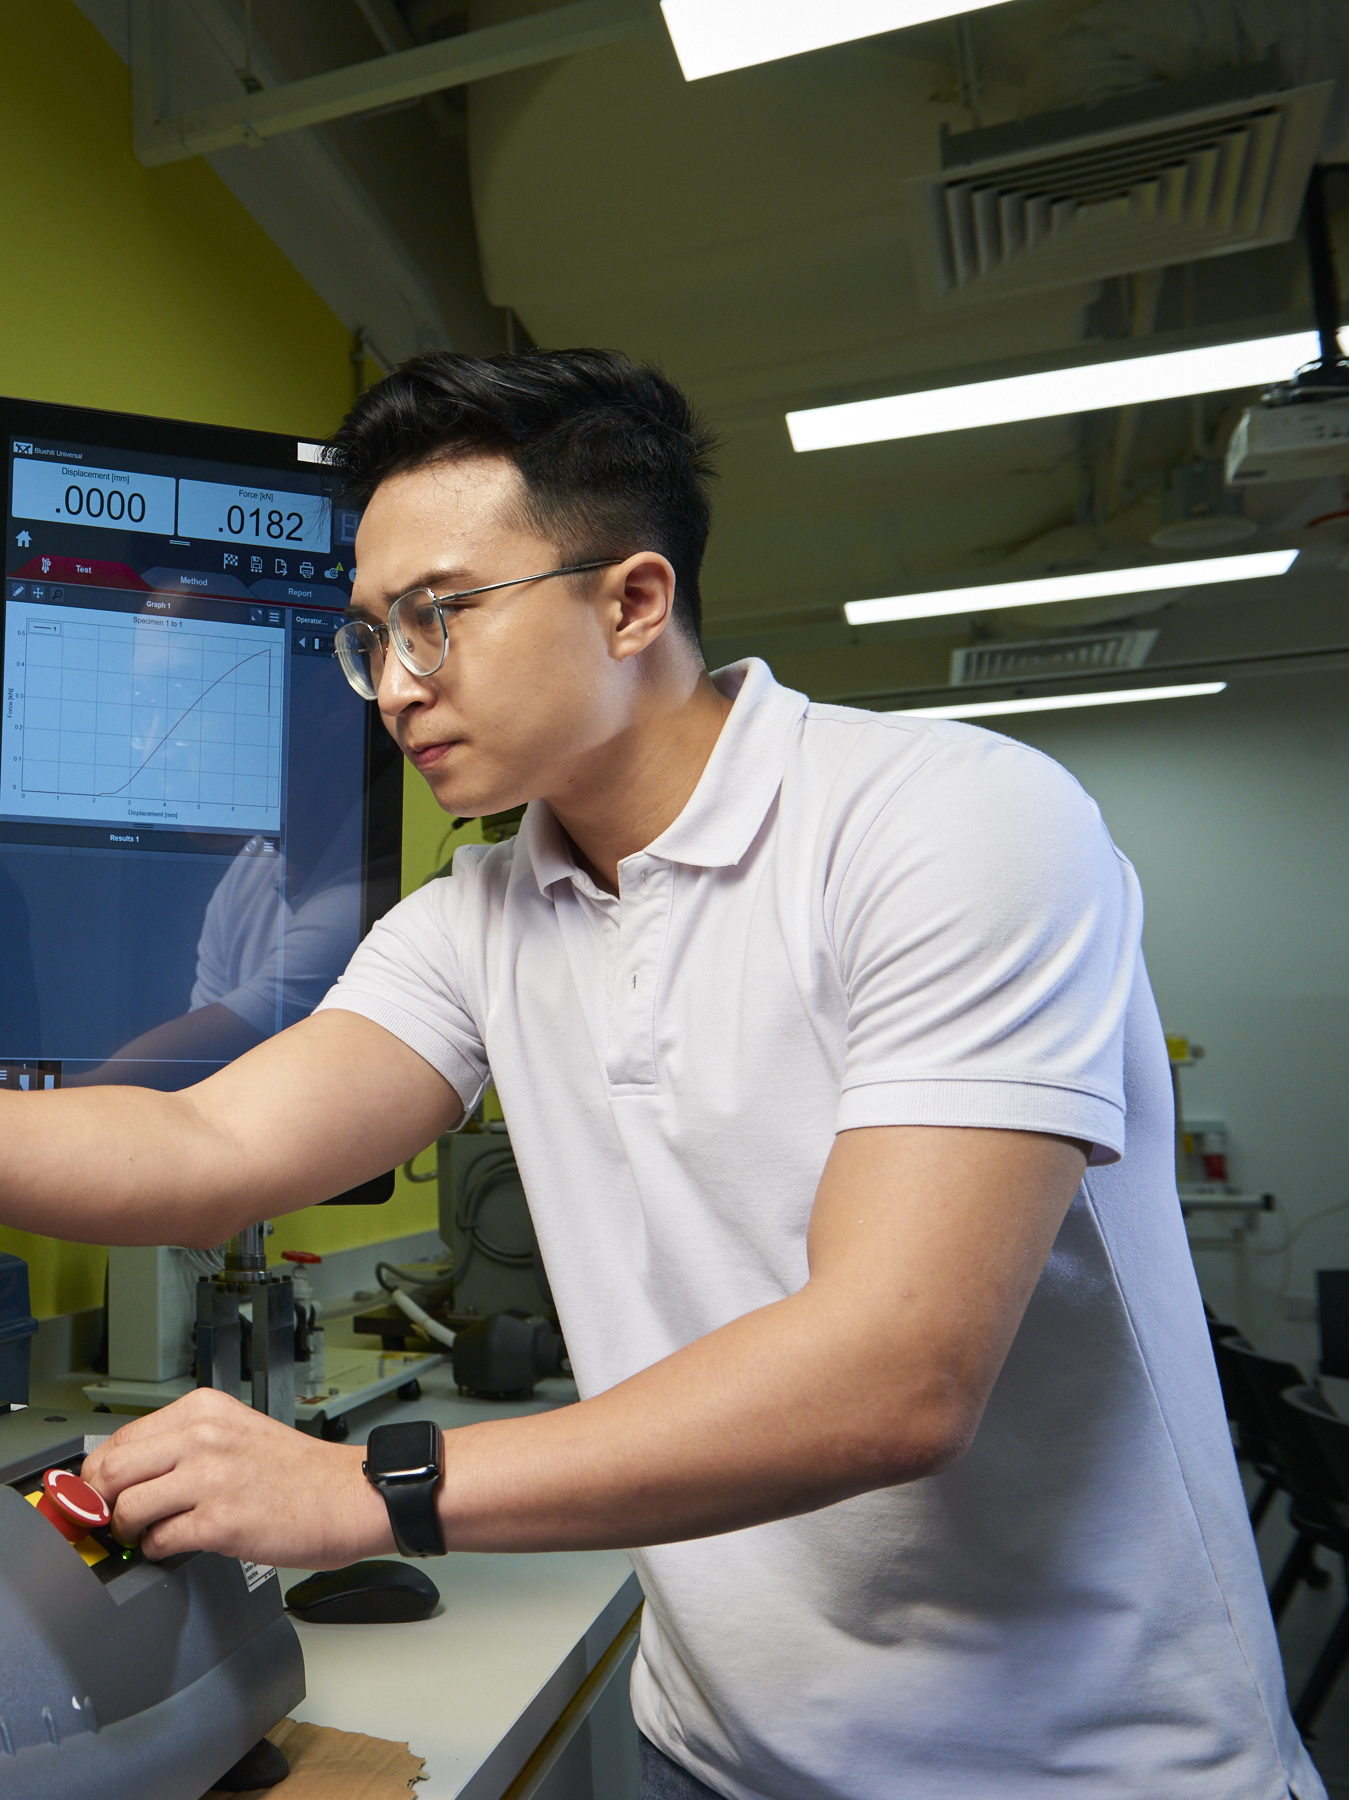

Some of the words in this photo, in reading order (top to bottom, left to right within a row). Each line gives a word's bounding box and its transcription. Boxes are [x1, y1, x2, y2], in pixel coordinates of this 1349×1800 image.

[34, 447, 55, 456] Bluehill
[56, 450, 83, 460] Universal
[61, 467, 110, 481] Displacement
[111, 473, 130, 484] [mm]
[238, 489, 258, 499] Force
[259, 492, 274, 502] [kN]
[56, 485, 146, 523] .0000
[218, 505, 303, 542] .0182
[76, 564, 92, 574] Test
[180, 576, 208, 586] Method
[288, 587, 313, 598] Report
[146, 600, 166, 610] Graph
[133, 616, 164, 626] Specimen
[128, 809, 164, 818] Displacement
[109, 834, 134, 842] Results
